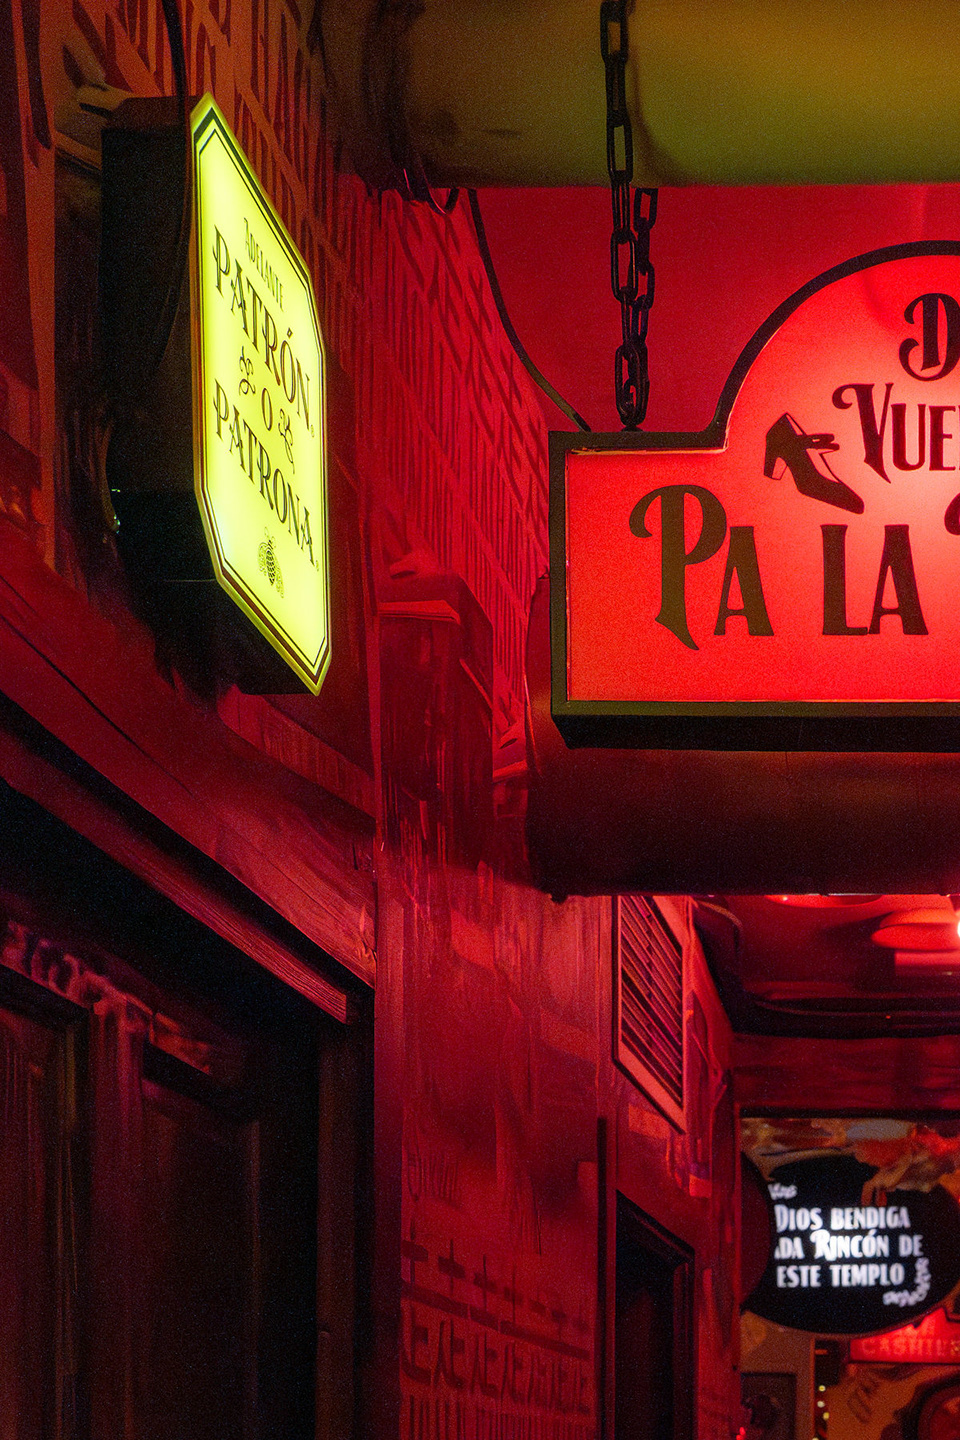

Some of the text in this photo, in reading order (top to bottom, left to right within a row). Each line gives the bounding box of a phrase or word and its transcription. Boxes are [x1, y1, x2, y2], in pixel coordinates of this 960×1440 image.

[243, 217, 284, 312] ADELANTE
[628, 484, 775, 651] PA
[821, 523, 929, 637] LA
[830, 1206, 911, 1230] BENDIGA
[809, 1229, 890, 1261] RINCÓN
[898, 1234, 924, 1257] DE
[776, 1265, 822, 1288] ESTE
[829, 1262, 906, 1288] TEMPLO
